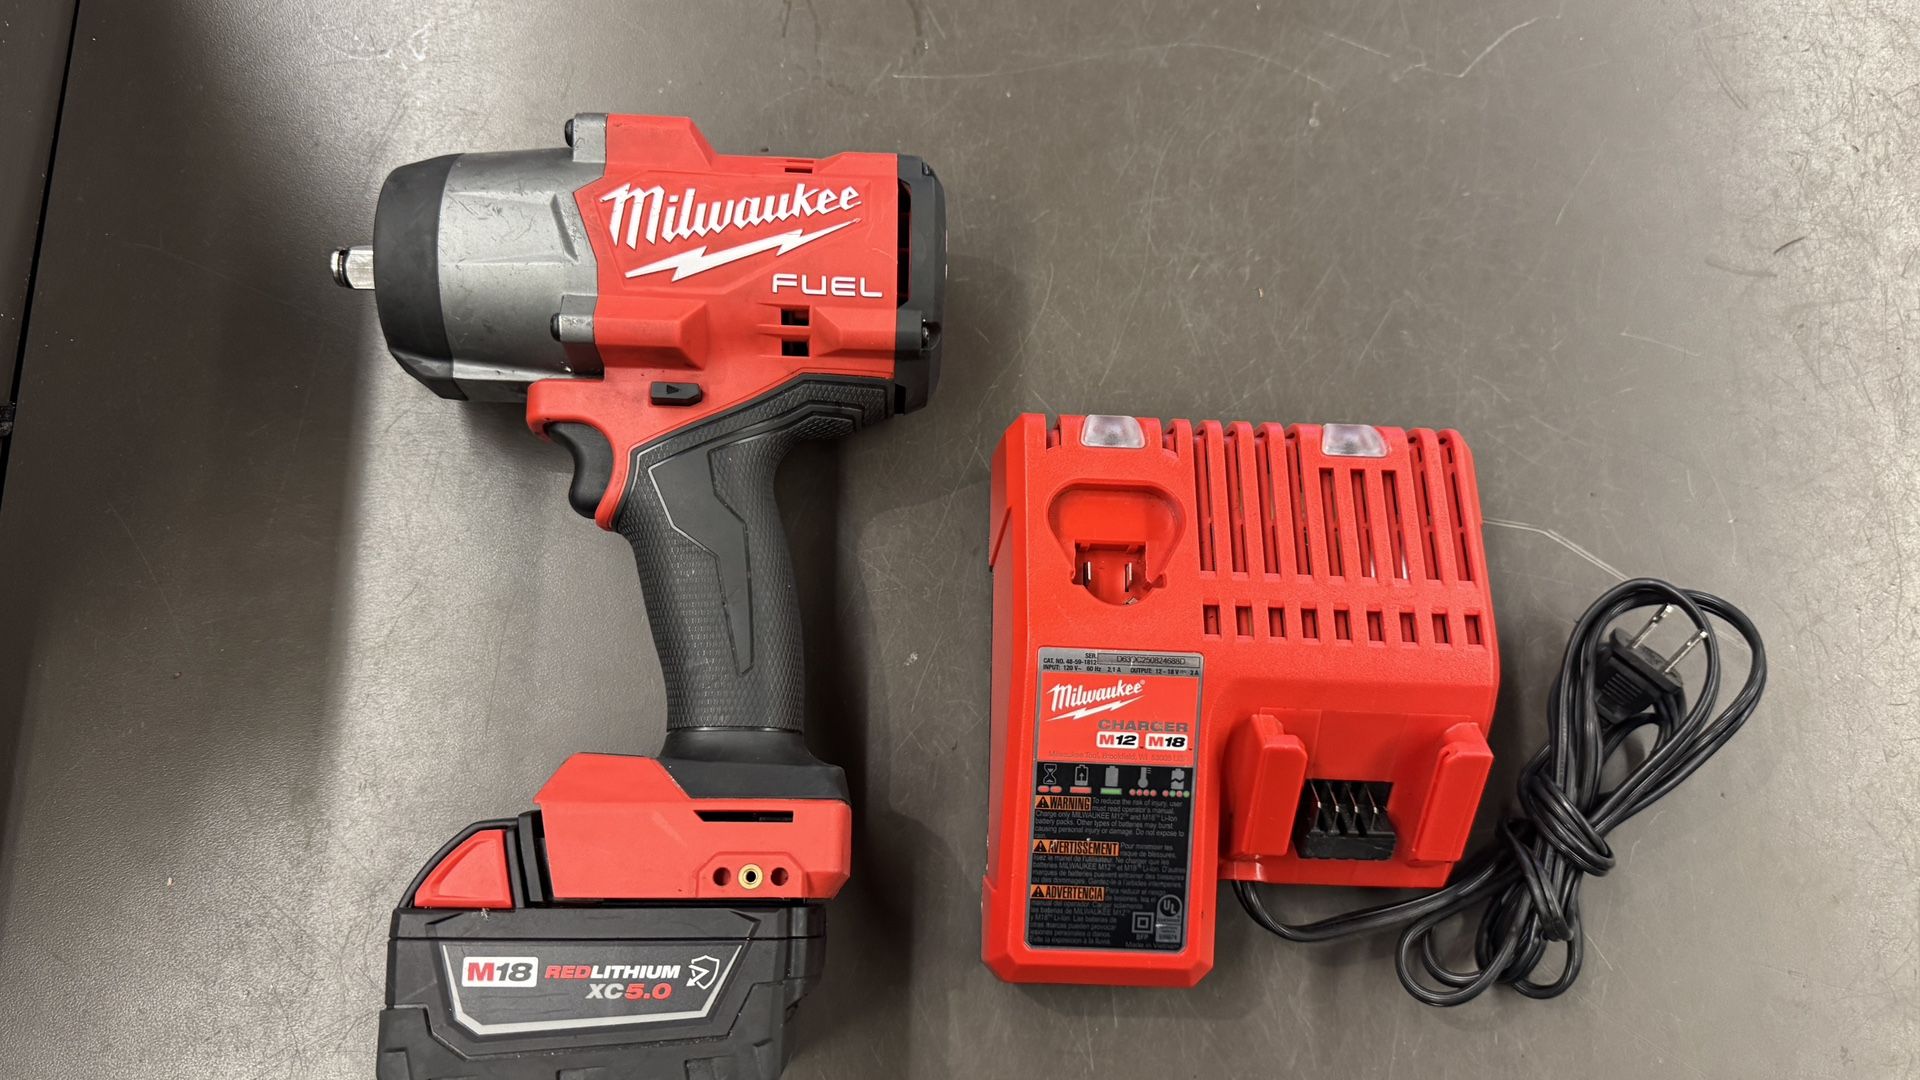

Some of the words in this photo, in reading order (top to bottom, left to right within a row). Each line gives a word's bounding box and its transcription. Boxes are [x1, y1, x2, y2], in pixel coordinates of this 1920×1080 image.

[601, 182, 862, 250] Milwaukee
[772, 273, 883, 298] FUEL
[1098, 720, 1189, 732] CHARGER
[1099, 734, 1137, 747] M12
[1148, 735, 1186, 748] M18
[1050, 797, 1090, 809] WARNING
[1036, 810, 1057, 818] Charge
[1144, 822, 1157, 830] may
[1049, 841, 1118, 855] AVERTISSEMENT
[1059, 862, 1096, 870] MILWAUKEE
[1046, 886, 1103, 900] ADVERTENCIA
[1074, 908, 1111, 916] MILWAUKEE
[1164, 900, 1176, 914] UL
[467, 962, 534, 982] M18
[545, 965, 681, 979] REDLITHIUM
[585, 983, 672, 1000] XC5.0
